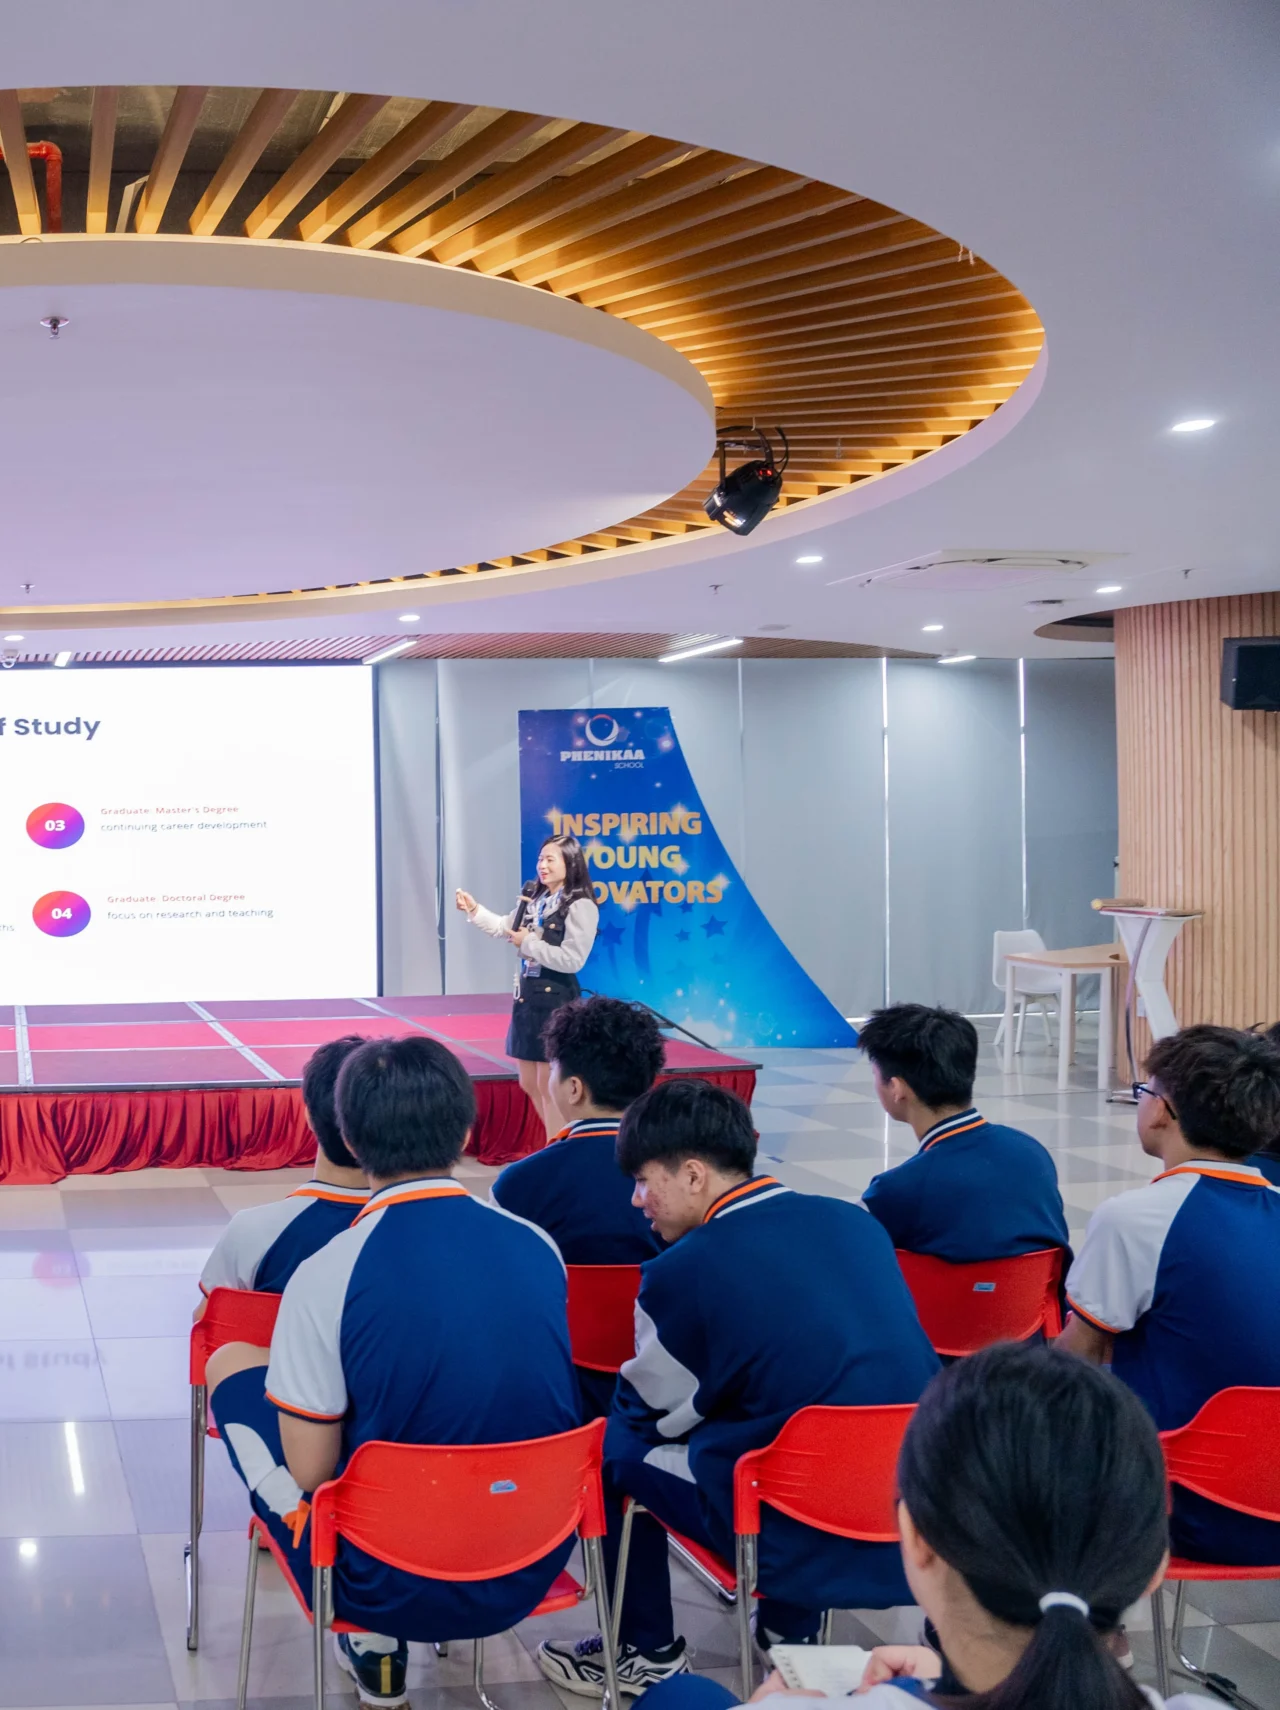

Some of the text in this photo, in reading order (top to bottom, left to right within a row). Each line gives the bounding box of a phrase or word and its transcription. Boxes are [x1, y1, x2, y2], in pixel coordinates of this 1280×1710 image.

[13, 716, 102, 741] Study
[560, 749, 646, 762] PHENIKAA
[202, 805, 240, 815] Degree
[44, 819, 66, 832] 03
[100, 820, 268, 833] continuing career development
[552, 812, 702, 837] INSPIRING
[161, 893, 207, 903] Doctoral
[209, 893, 246, 903] Degree
[591, 880, 723, 905] OVATORS
[51, 907, 73, 920] 04
[107, 908, 275, 920] focus on research and teaching
